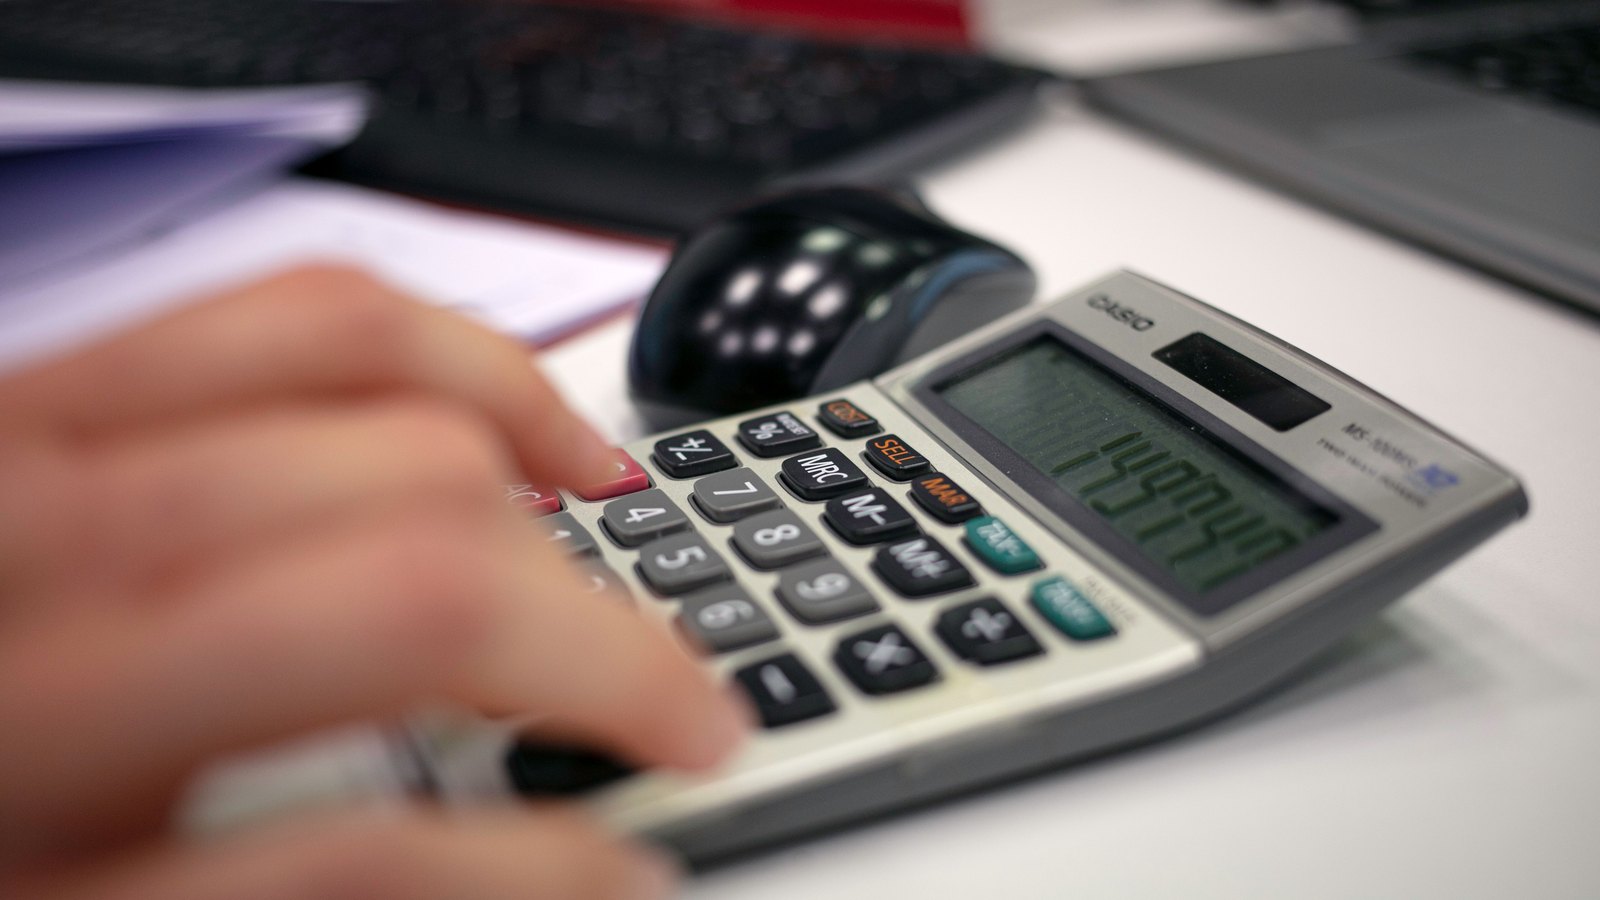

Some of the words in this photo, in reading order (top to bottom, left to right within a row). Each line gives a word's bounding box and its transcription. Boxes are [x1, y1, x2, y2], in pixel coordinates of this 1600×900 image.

[1087, 292, 1154, 331] CASIO
[749, 422, 784, 439] %
[874, 439, 916, 465] SELL
[797, 454, 848, 484] MRC
[713, 481, 758, 496] 7
[625, 507, 667, 523] 4
[842, 493, 887, 525] M-
[753, 524, 800, 546] 8
[655, 546, 706, 569] 5
[796, 573, 849, 600] 9
[697, 600, 754, 629] 6
